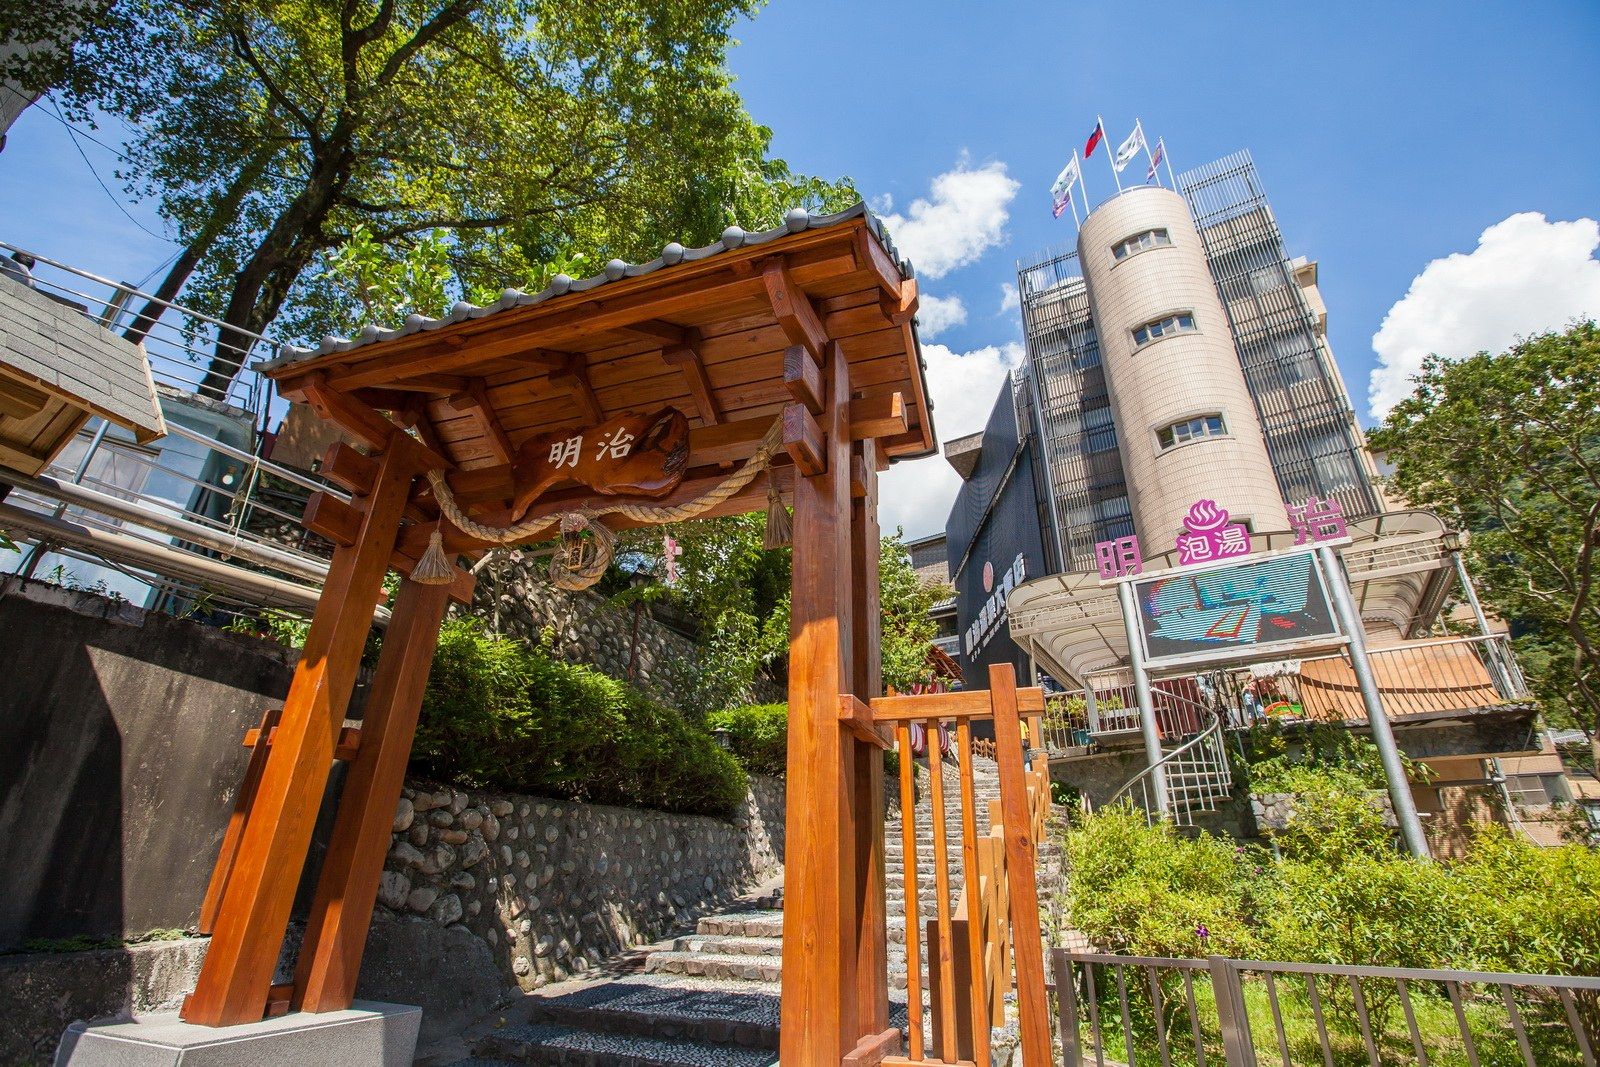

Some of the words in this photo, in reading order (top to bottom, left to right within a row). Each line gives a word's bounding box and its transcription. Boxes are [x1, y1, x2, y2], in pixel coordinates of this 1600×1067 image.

[548, 426, 634, 469] 明治
[1096, 535, 1142, 579] 明
[1284, 496, 1347, 545] 治
[1181, 528, 1247, 561] 泡湯
